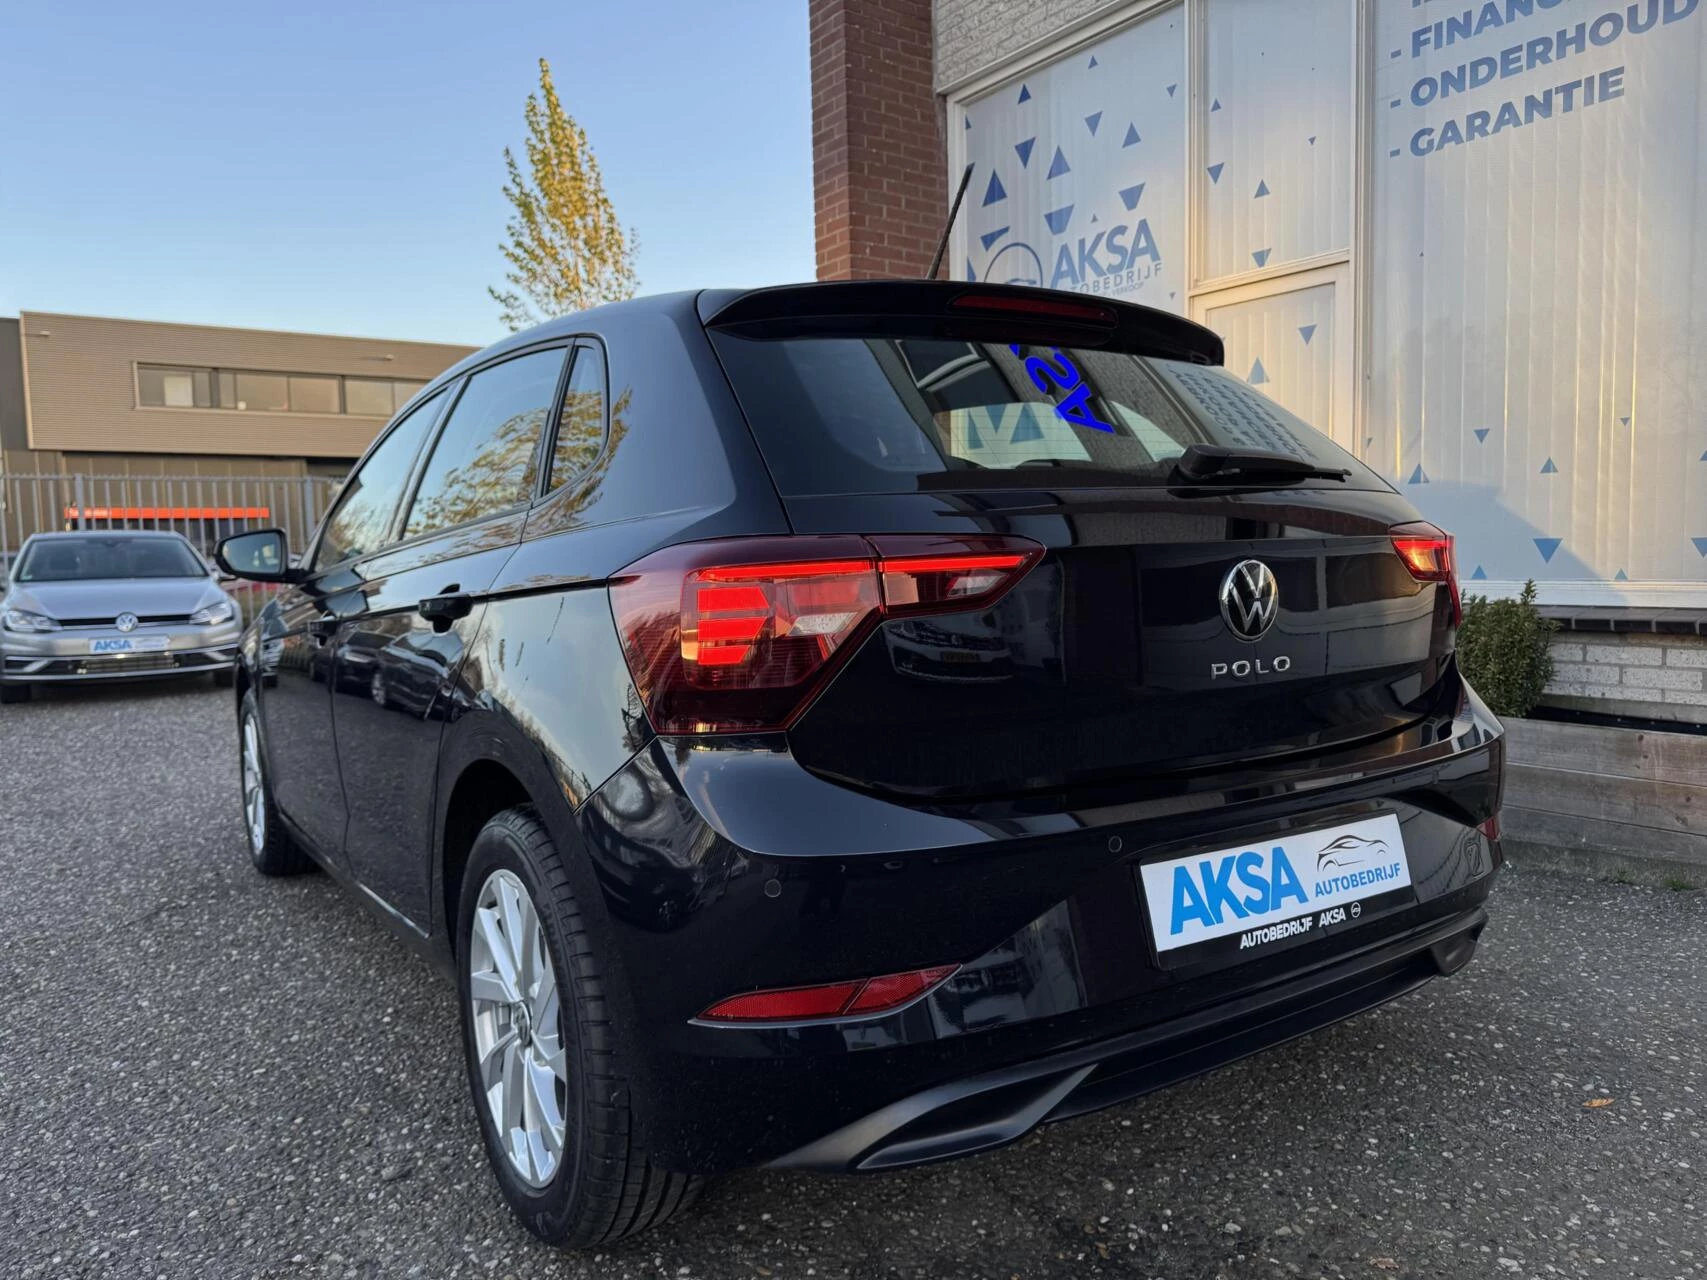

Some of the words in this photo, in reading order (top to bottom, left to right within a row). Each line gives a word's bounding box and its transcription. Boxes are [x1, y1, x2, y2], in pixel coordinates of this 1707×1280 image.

[1410, 0, 1699, 107] ONDERHOUD
[1409, 66, 1625, 157] GARANTIE
[1051, 218, 1161, 288] AKSA
[94, 639, 133, 653] AKSA
[1210, 655, 1291, 680] POLO
[1170, 846, 1309, 935] AKSA
[1314, 862, 1400, 898] AUTOBEDRIJF
[1240, 916, 1313, 950] AUTOBEDRIJF
[1318, 907, 1346, 928] AKSA
